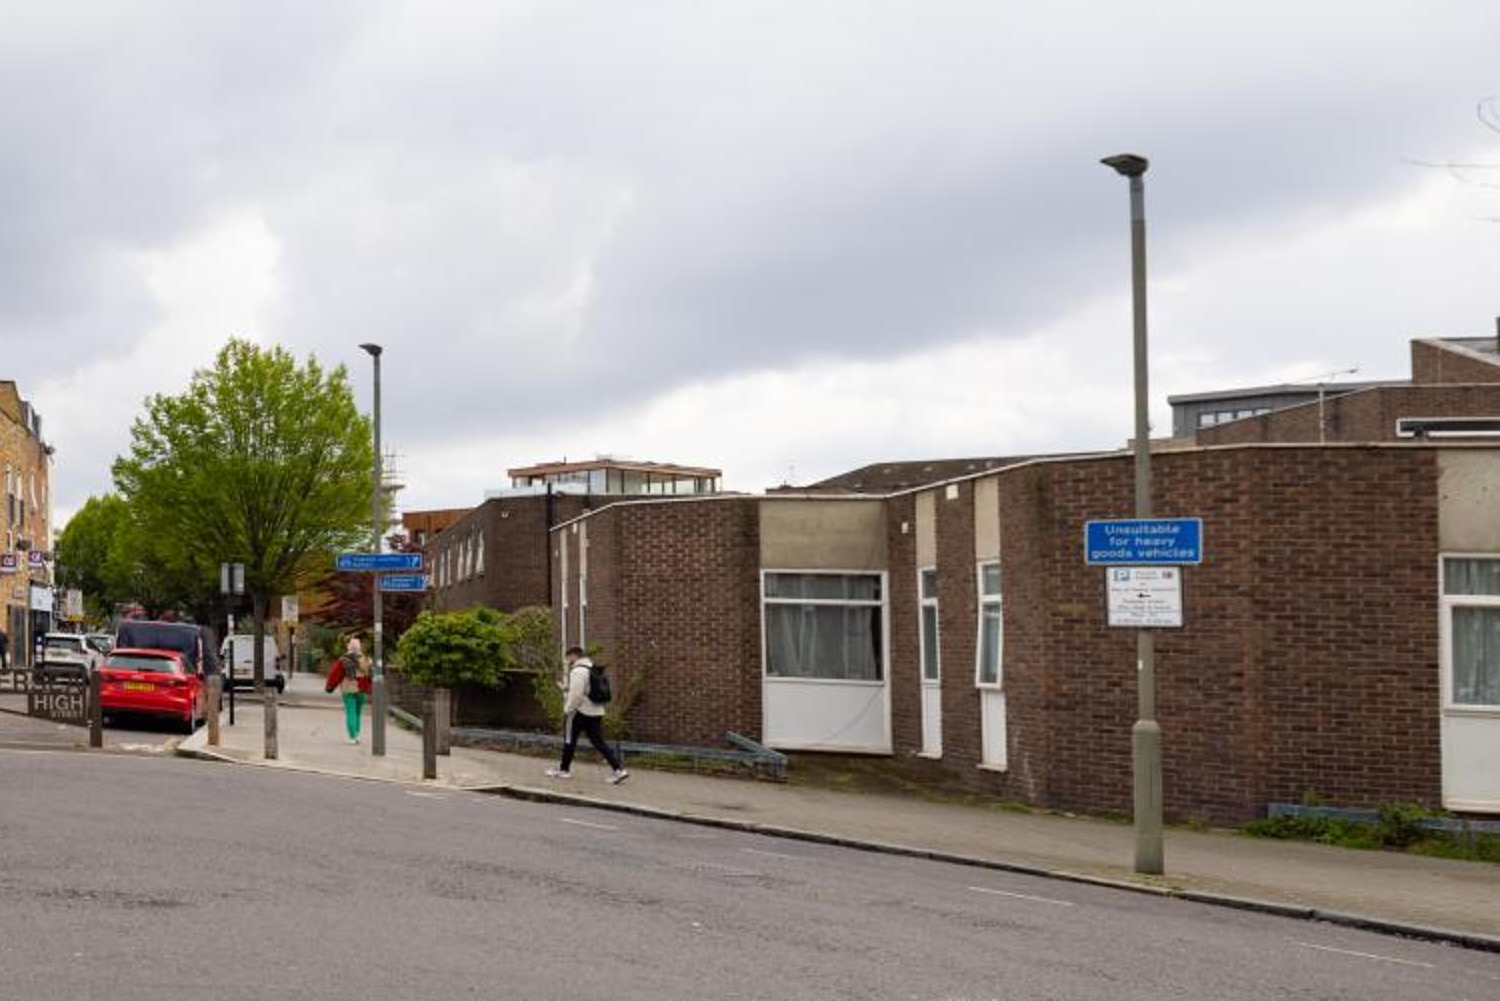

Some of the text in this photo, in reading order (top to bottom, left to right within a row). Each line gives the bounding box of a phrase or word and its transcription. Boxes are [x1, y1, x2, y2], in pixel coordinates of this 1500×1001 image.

[1104, 524, 1180, 535] Unsuitable
[1109, 537, 1176, 547] for heavy
[1091, 547, 1195, 559] goods vehicles
[33, 695, 83, 711] HIGH
